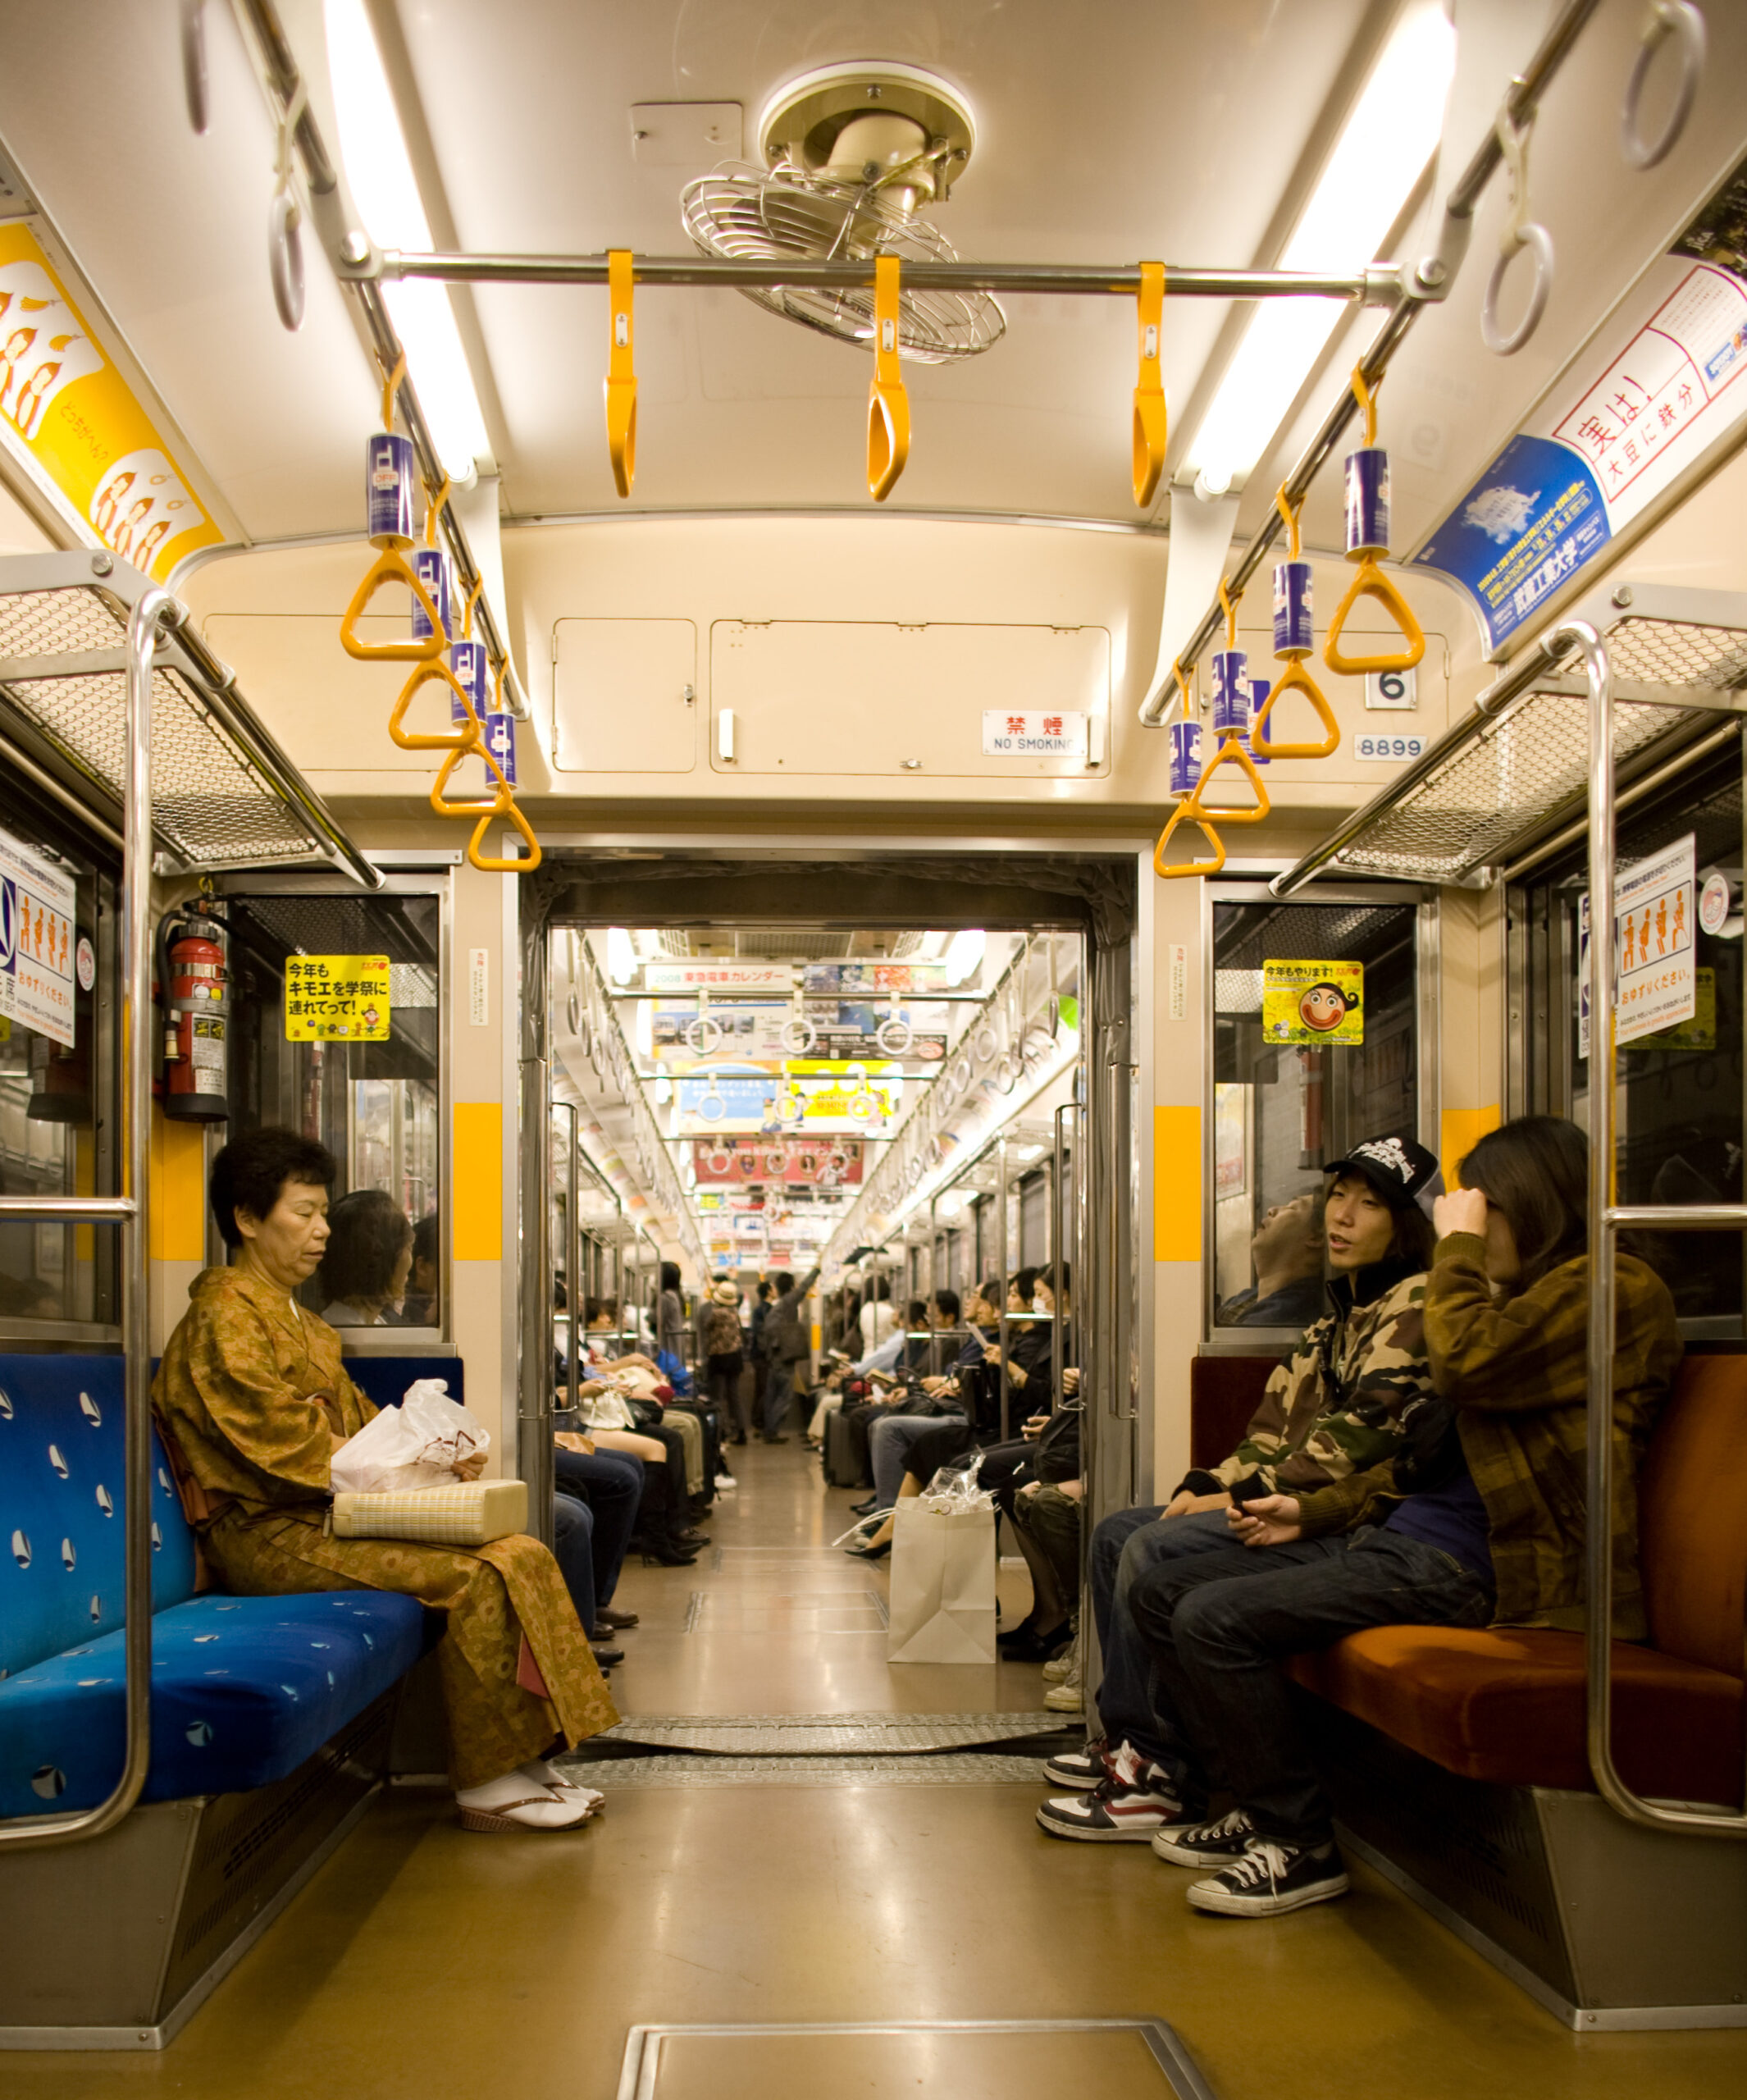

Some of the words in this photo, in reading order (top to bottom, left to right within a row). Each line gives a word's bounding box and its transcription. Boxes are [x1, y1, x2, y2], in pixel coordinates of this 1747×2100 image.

[375, 474, 396, 483] OFF
[1379, 670, 1405, 701] 6
[1006, 716, 1063, 736] 禁煙
[994, 738, 1011, 749] NO
[1361, 739, 1421, 756] 8899
[289, 963, 329, 978] 今年も
[655, 973, 681, 984] 2008
[685, 971, 785, 983] 東急電車カレンダー
[1266, 966, 1333, 977] 今年もやります!
[289, 981, 387, 997] キモエを学祭に
[1621, 968, 1690, 1006] おゆずりください。
[289, 1000, 356, 1016] 連れてって!
